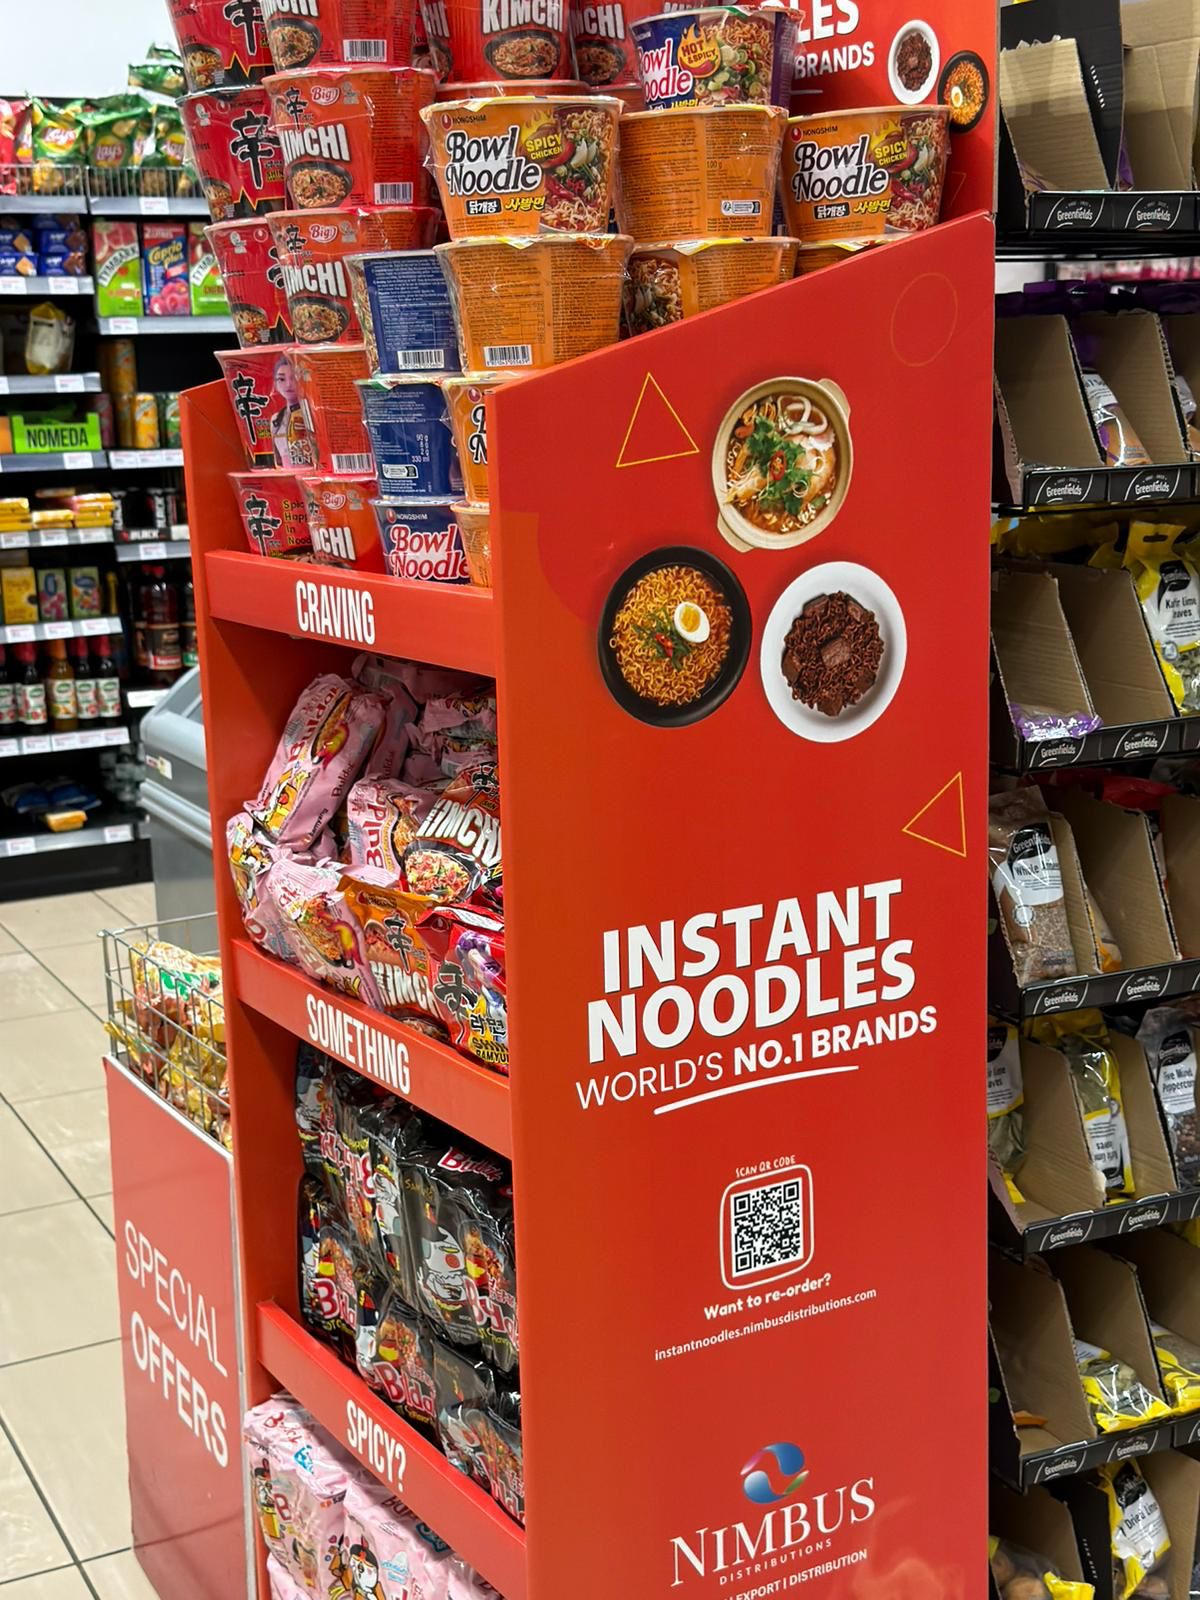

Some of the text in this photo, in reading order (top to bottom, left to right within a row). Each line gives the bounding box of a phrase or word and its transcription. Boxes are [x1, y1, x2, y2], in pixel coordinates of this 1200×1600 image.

[638, 38, 672, 74] owl
[681, 40, 704, 57] HOT
[794, 41, 875, 79] BRANDS
[446, 126, 518, 163] Bowl
[526, 134, 562, 152] SPICY
[803, 126, 838, 136] NONGSHIM
[229, 108, 281, 190] 辛
[530, 146, 563, 160] CHICKEN
[794, 135, 869, 172] Bowl
[874, 141, 908, 158] SPICY
[879, 154, 908, 166] CHICKEN
[445, 158, 541, 195] Noodle
[792, 165, 888, 202] Noodle
[1057, 207, 1093, 222] Greenfields
[1136, 207, 1171, 222] Greenfields
[232, 371, 269, 445] 辛
[26, 427, 89, 449] NOMEDA
[1046, 483, 1082, 498] Greenfields
[1135, 480, 1170, 495] Greenfields
[390, 524, 457, 553] Bowl
[296, 580, 375, 645] CRAVING
[1041, 743, 1076, 758] Greenfields
[1124, 735, 1158, 751] Greenfields
[603, 879, 902, 994] INSTANT
[587, 939, 916, 1064] NOODLES
[1044, 991, 1079, 1006] Greenfields
[1126, 980, 1161, 995] Greenfields
[305, 992, 410, 1095] SOMETHING
[475, 1049, 509, 1065] RAMYU
[575, 1005, 938, 1110] WORLD'S NO.1 BRANDS
[735, 1155, 796, 1178] SCAN QR CODE
[1128, 1210, 1161, 1225] Greenfields
[1050, 1227, 1084, 1243] Greenfields
[124, 1219, 228, 1378] SPECIAL
[704, 1273, 832, 1321] Want to re-order?
[655, 1289, 877, 1361] instantnoodles.nimbusdistributions.com
[130, 1310, 229, 1468] OFFERS
[346, 1399, 407, 1493] SPICY?
[1116, 1440, 1149, 1456] Greenfields
[1044, 1459, 1077, 1475] Greenfields
[669, 1477, 876, 1588] NIMBUS
[719, 1538, 833, 1586] DISTRIBUTIONS
[736, 1549, 868, 1600] EXPORT DISTRIBUTION
